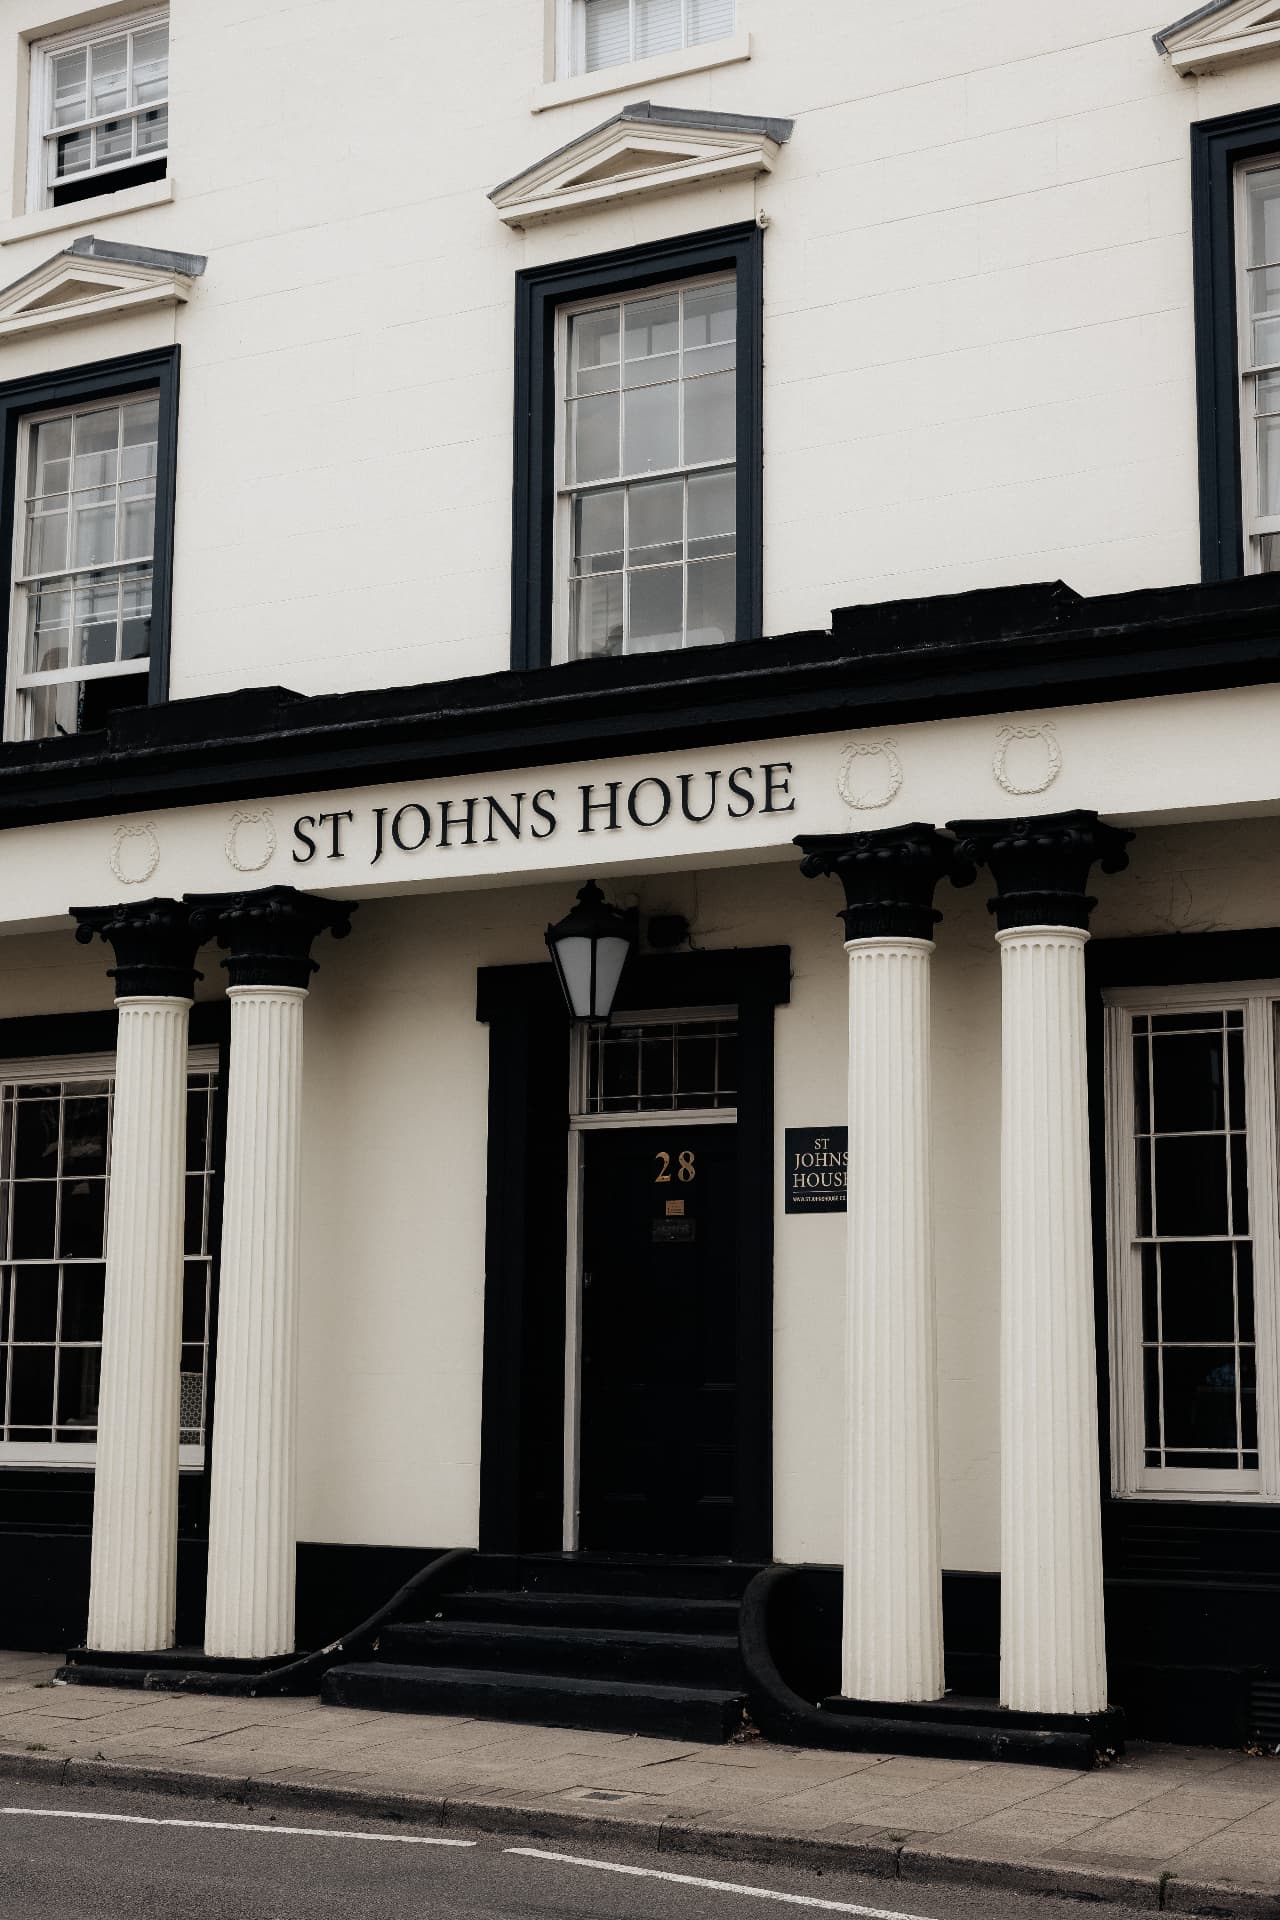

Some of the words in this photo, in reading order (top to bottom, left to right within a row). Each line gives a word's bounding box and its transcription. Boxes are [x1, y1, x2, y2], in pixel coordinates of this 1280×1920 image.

[291, 808, 353, 864] ST
[370, 788, 557, 866] JOHNS
[577, 762, 796, 834] HOUSE
[814, 1138, 830, 1150] ST
[655, 1150, 696, 1183] 28
[794, 1151, 848, 1170] JOHNS
